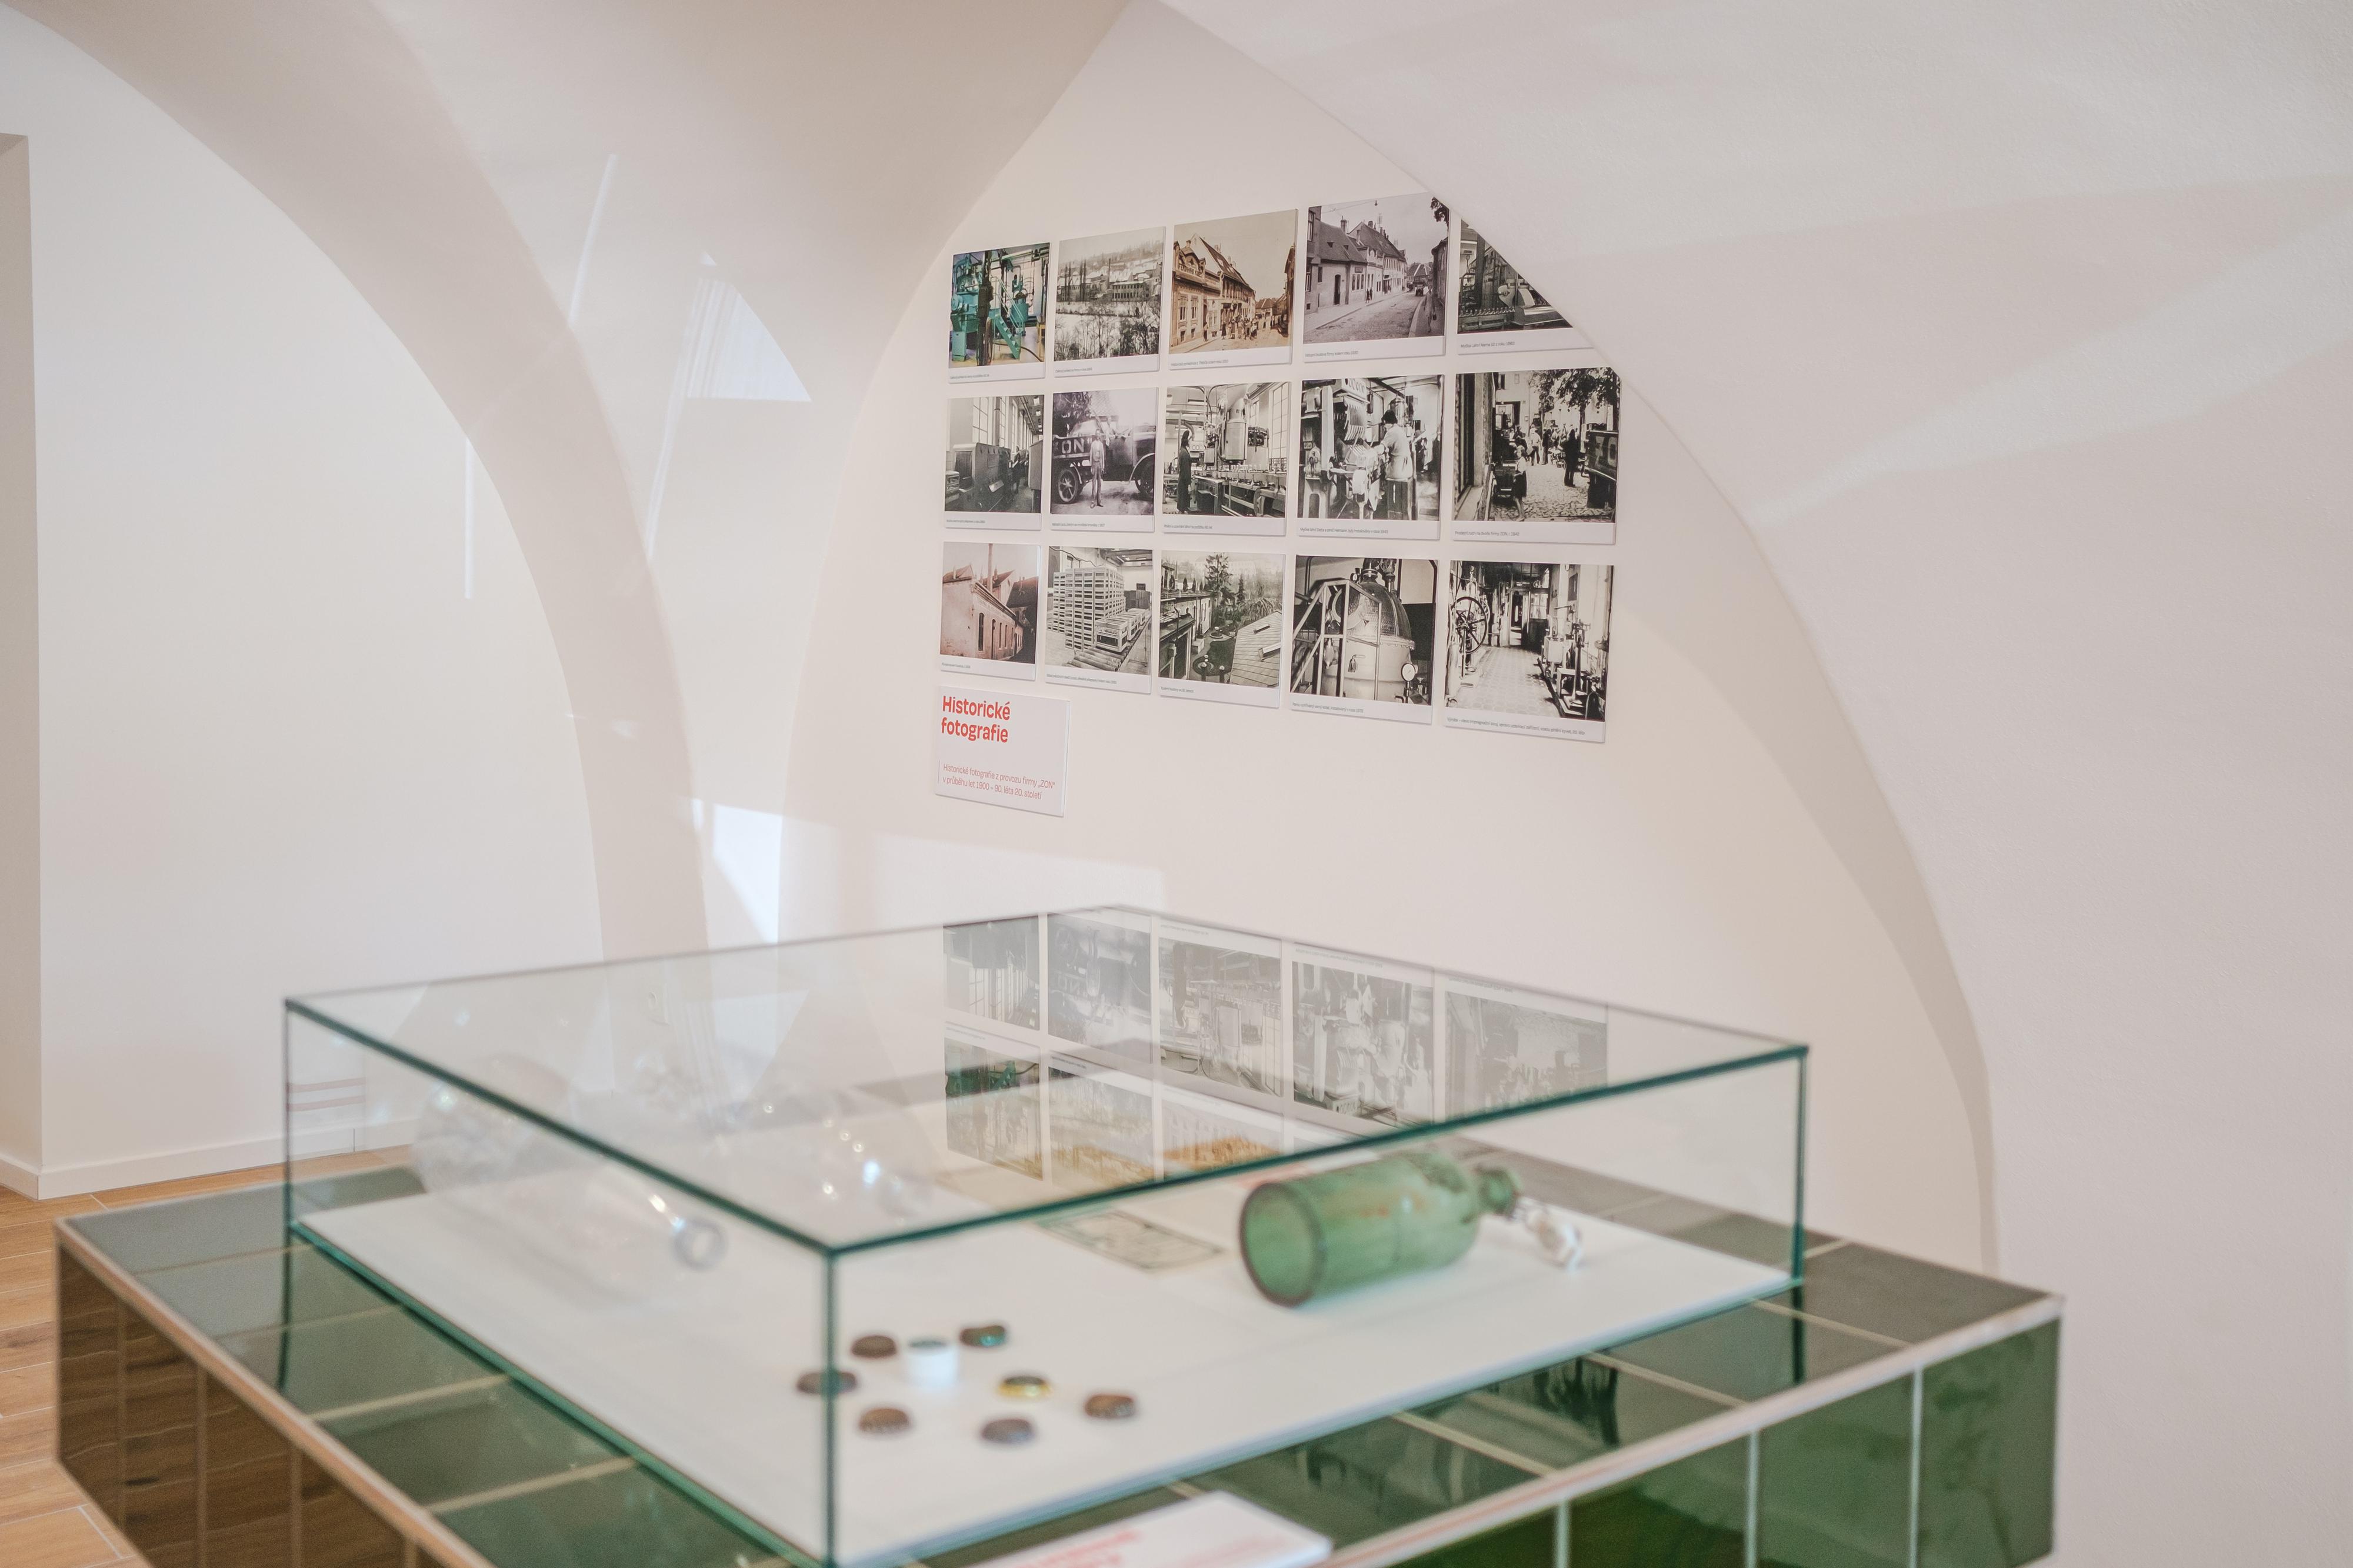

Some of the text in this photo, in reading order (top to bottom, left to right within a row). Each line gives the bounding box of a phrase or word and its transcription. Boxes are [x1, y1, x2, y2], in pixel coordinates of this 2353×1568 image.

[942, 695, 1010, 720] Historické
[941, 717, 1008, 743] fotografie
[943, 763, 969, 775] Historické
[969, 768, 995, 779] fotografie
[999, 775, 1021, 783] provozu
[1022, 776, 1038, 788] firmy
[946, 776, 968, 787] průběhu
[976, 782, 989, 790] 1900
[994, 785, 1002, 793] 90.
[1004, 785, 1014, 795] léta
[1015, 788, 1024, 796] 20.
[1024, 790, 1042, 799] století
